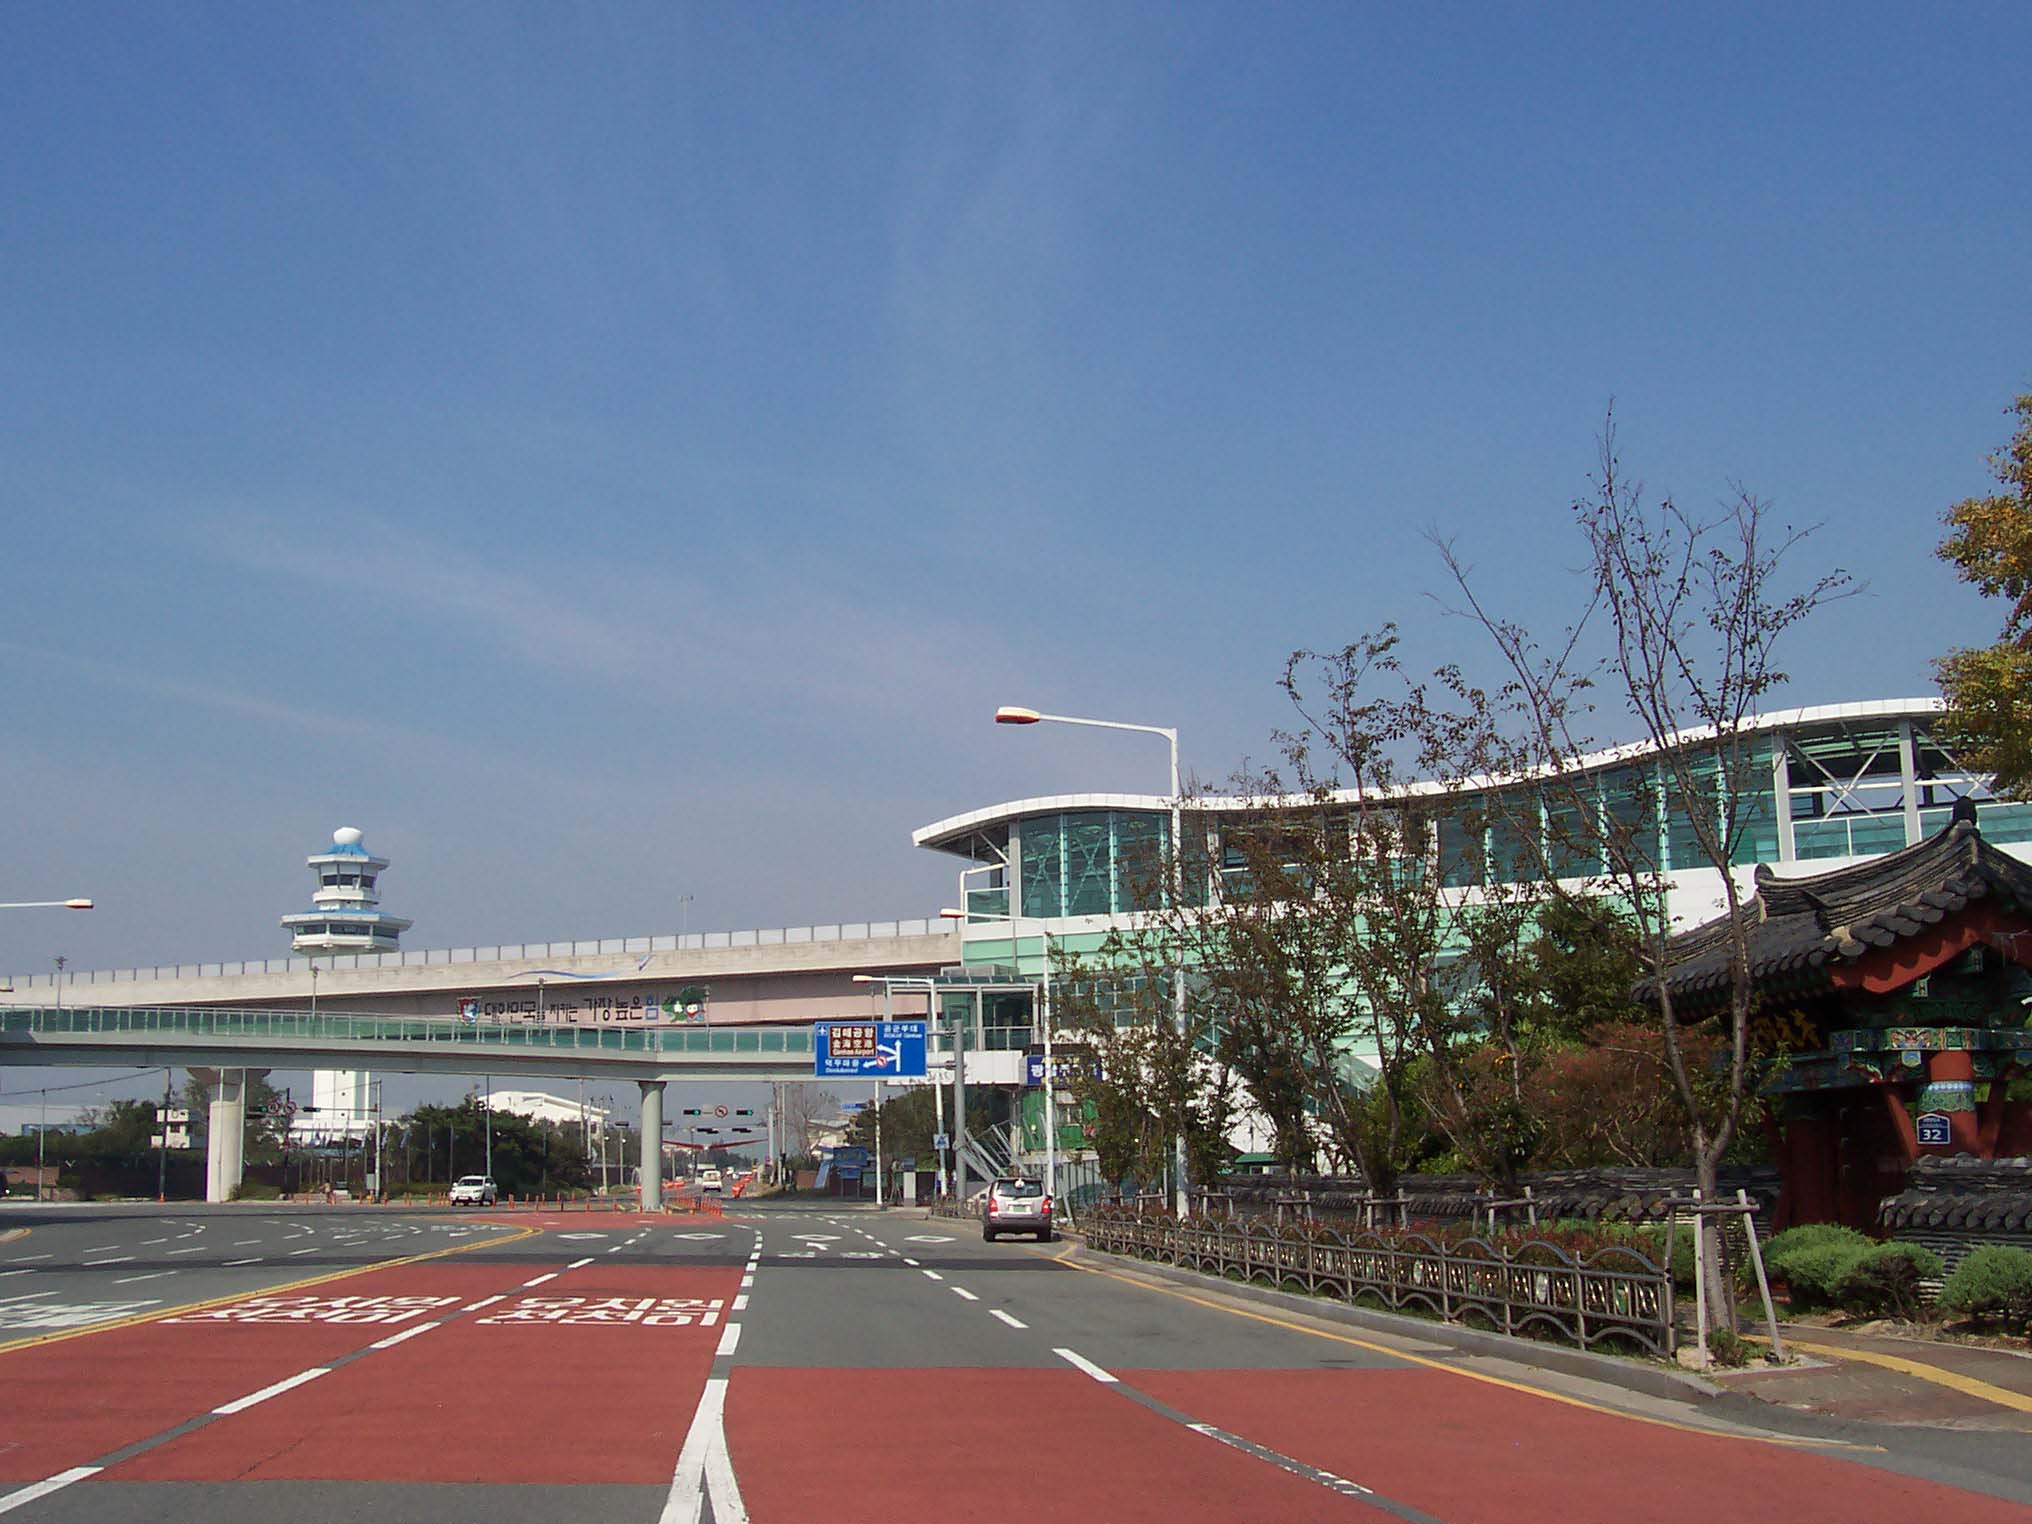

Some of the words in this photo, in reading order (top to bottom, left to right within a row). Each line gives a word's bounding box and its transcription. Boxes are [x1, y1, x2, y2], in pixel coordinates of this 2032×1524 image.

[550, 1003, 577, 1022] 지키는
[583, 997, 611, 1022] 가장
[615, 996, 642, 1020] 높은
[646, 995, 659, 1020] 힘
[832, 1027, 874, 1038] 김해공항
[855, 1048, 875, 1057] Airport
[1923, 1129, 1942, 1140] 32
